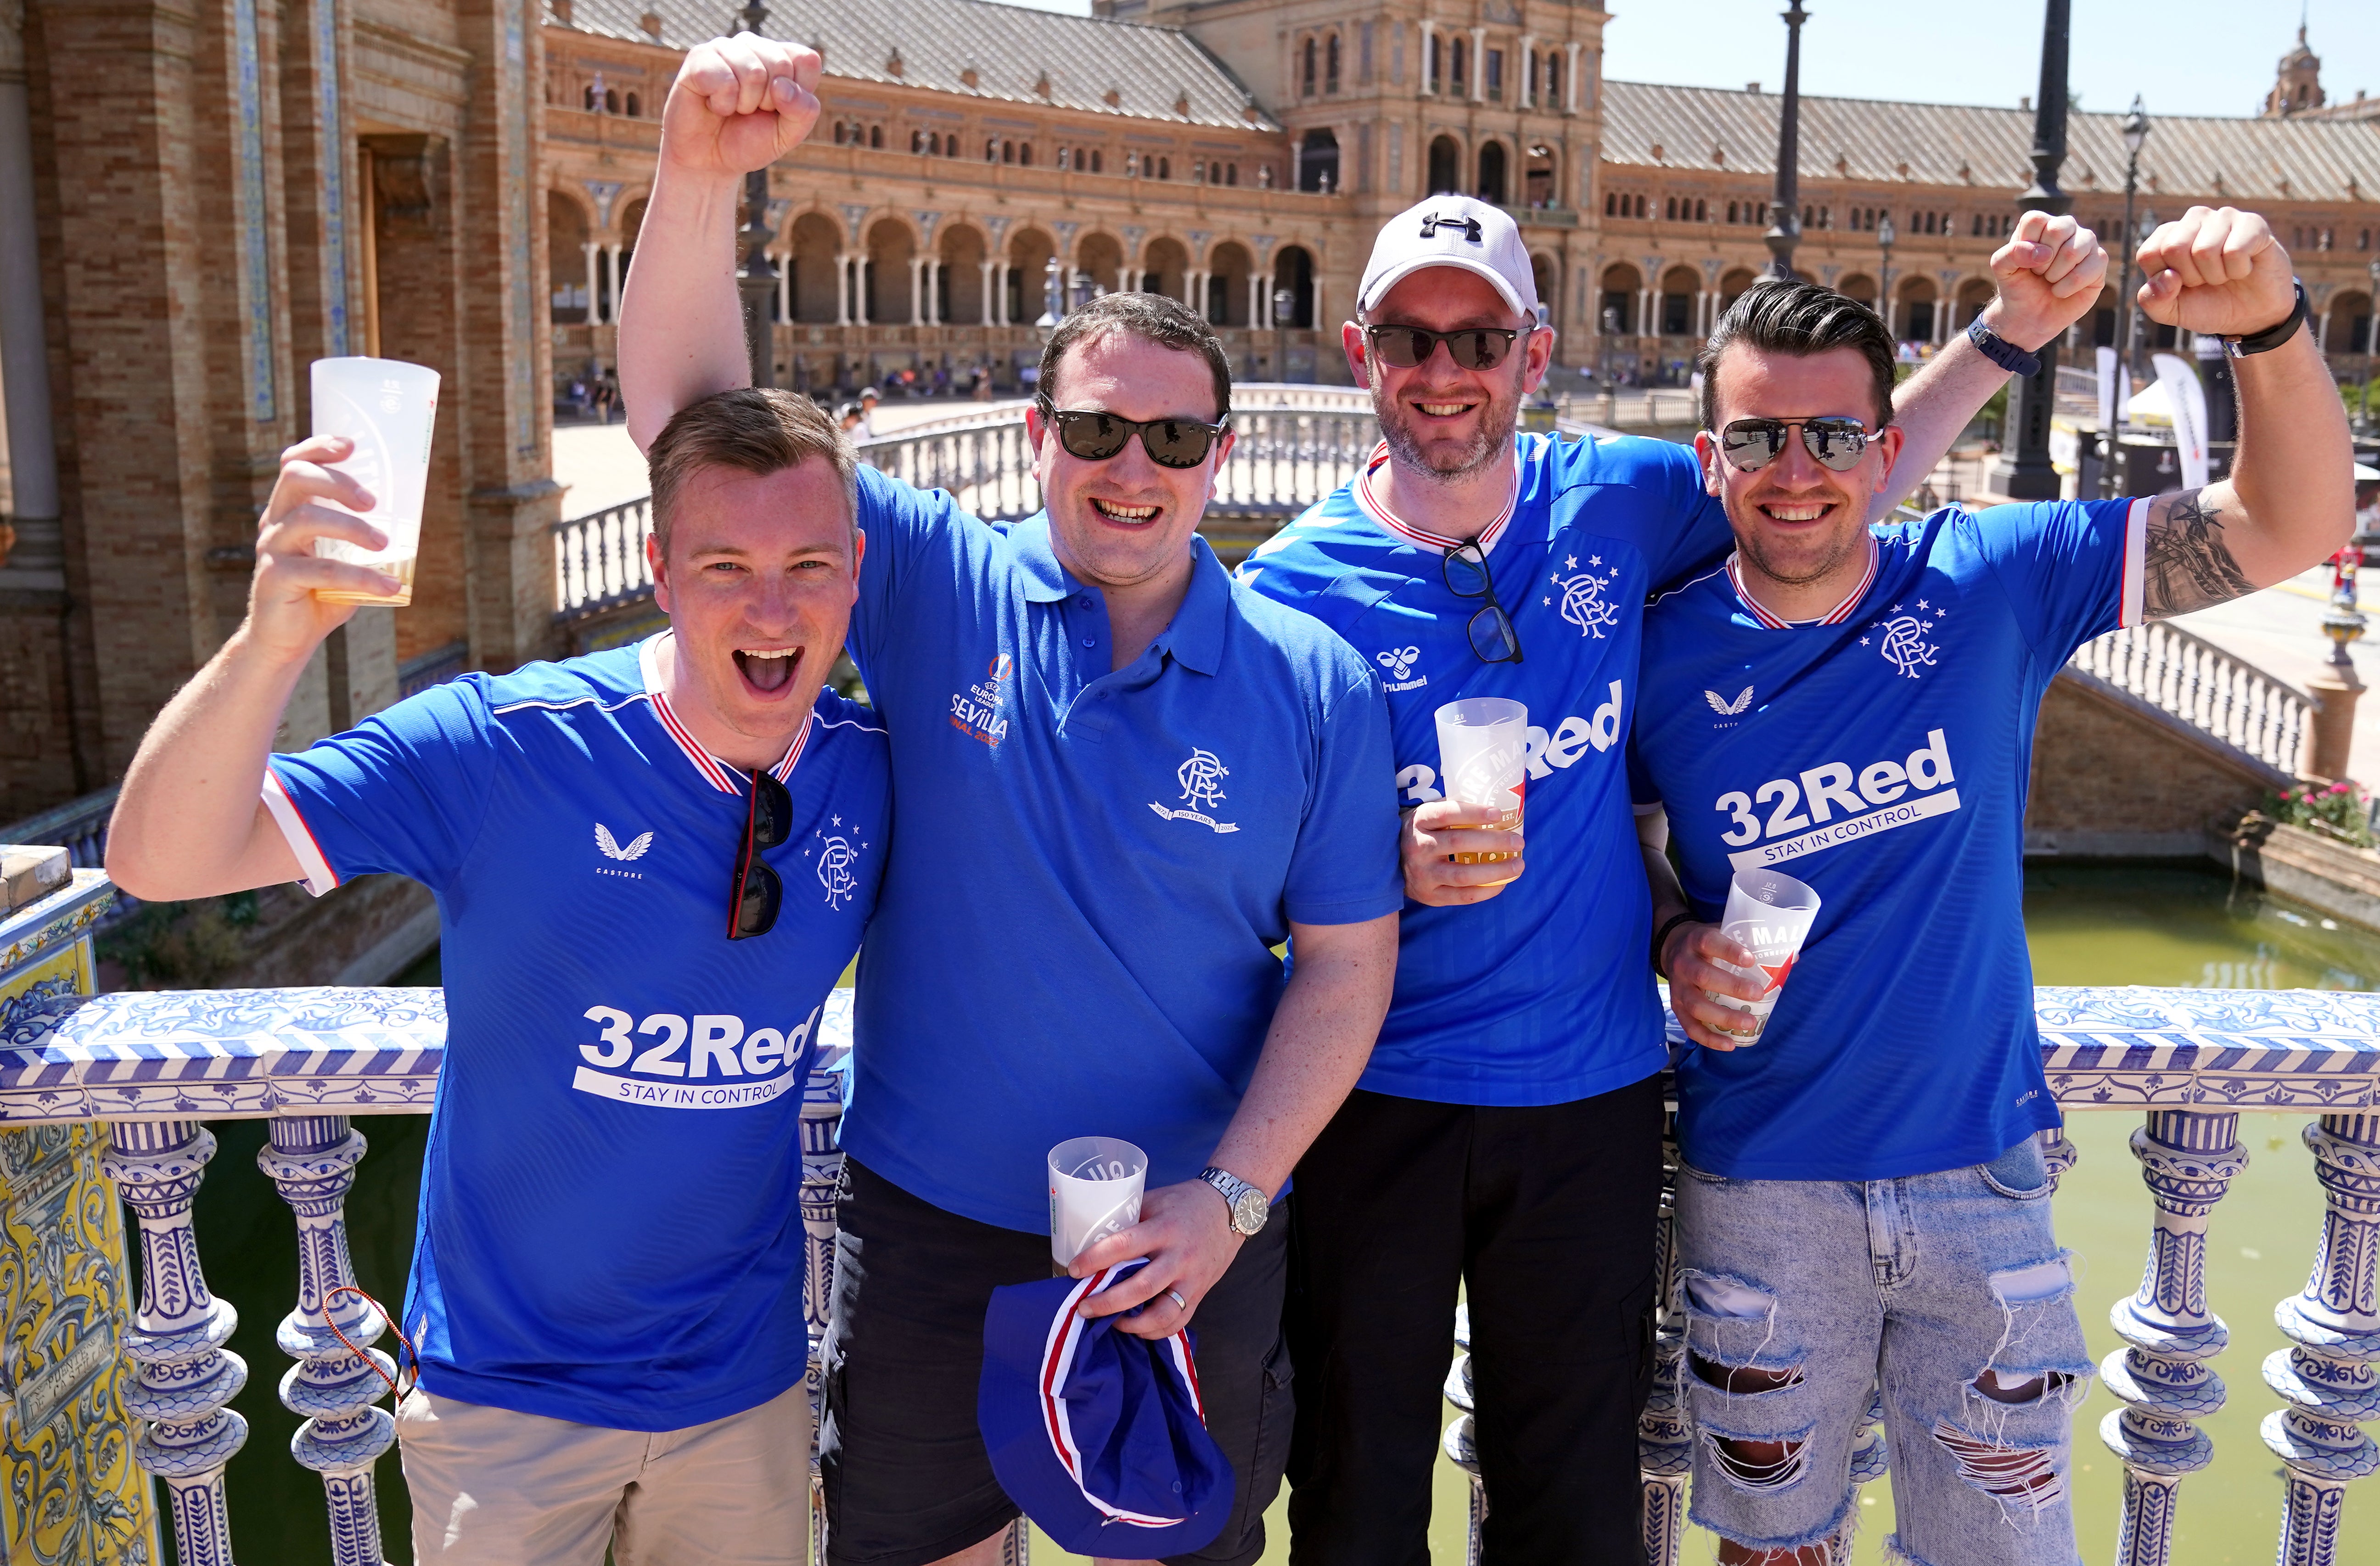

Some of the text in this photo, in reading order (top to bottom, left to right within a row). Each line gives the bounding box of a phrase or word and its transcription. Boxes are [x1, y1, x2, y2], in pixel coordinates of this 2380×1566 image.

[985, 684, 999, 692] UEFA
[1383, 675, 1427, 693] hummel
[971, 684, 1003, 706] EUROPA
[975, 696, 995, 709] LEAGUE
[974, 731, 999, 747] 2022
[1397, 679, 1622, 802] 3Red
[1459, 765, 1491, 804] URE
[1715, 728, 1955, 846] 32Red
[1156, 806, 1167, 815] 1872
[1191, 814, 1212, 824] YEARS
[1502, 813, 1515, 822] EST.
[1765, 804, 1922, 860] STAY IN CONTROL
[596, 868, 642, 879] CASTORE
[579, 1004, 822, 1078] 32Red
[619, 1082, 778, 1104] STAY IN CONTROL
